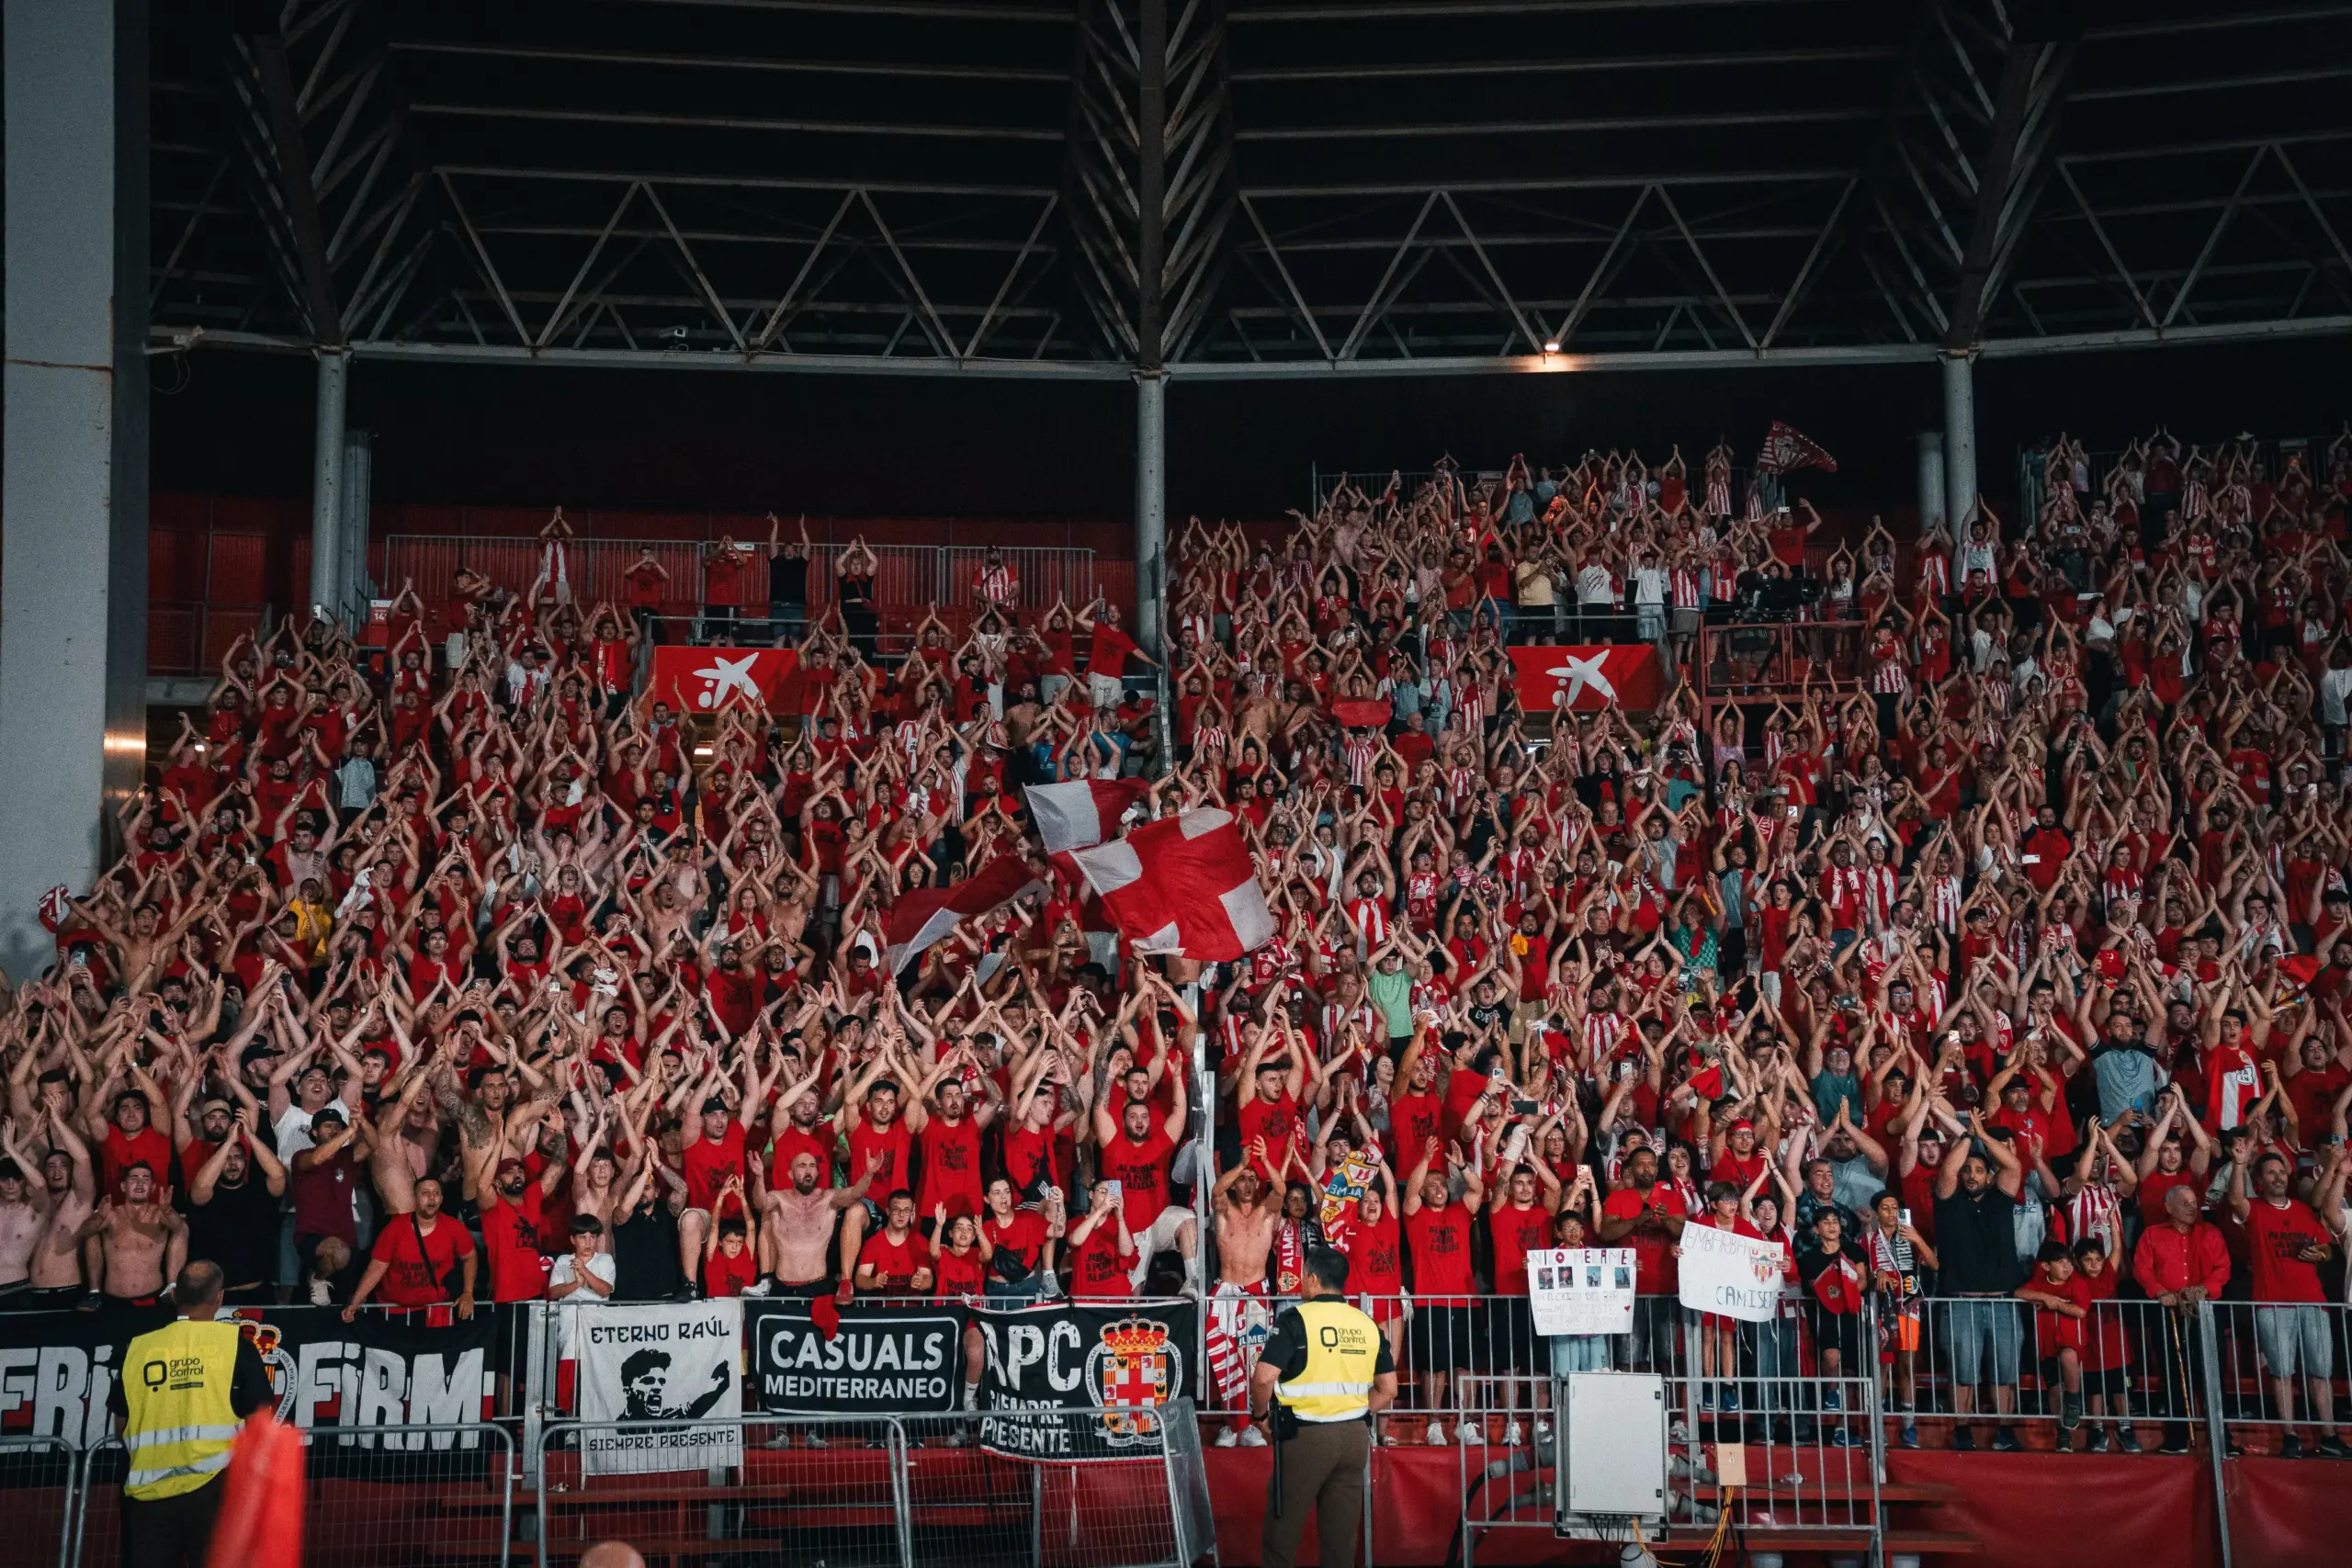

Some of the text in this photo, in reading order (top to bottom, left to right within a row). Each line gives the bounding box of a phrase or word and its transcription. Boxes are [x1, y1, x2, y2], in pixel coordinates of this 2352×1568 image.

[1283, 1226, 1295, 1268] ALME
[591, 1315, 730, 1344] ETERNO RAÚL
[1339, 1328, 1363, 1337] grupo
[1340, 1336, 1367, 1344] control
[770, 1330, 944, 1371] CASUALS
[169, 1358, 200, 1371] grupo
[169, 1365, 204, 1378] control
[765, 1374, 947, 1399] MEDITERRANEO
[589, 1429, 735, 1451] SIEMPRE PRESENTE
